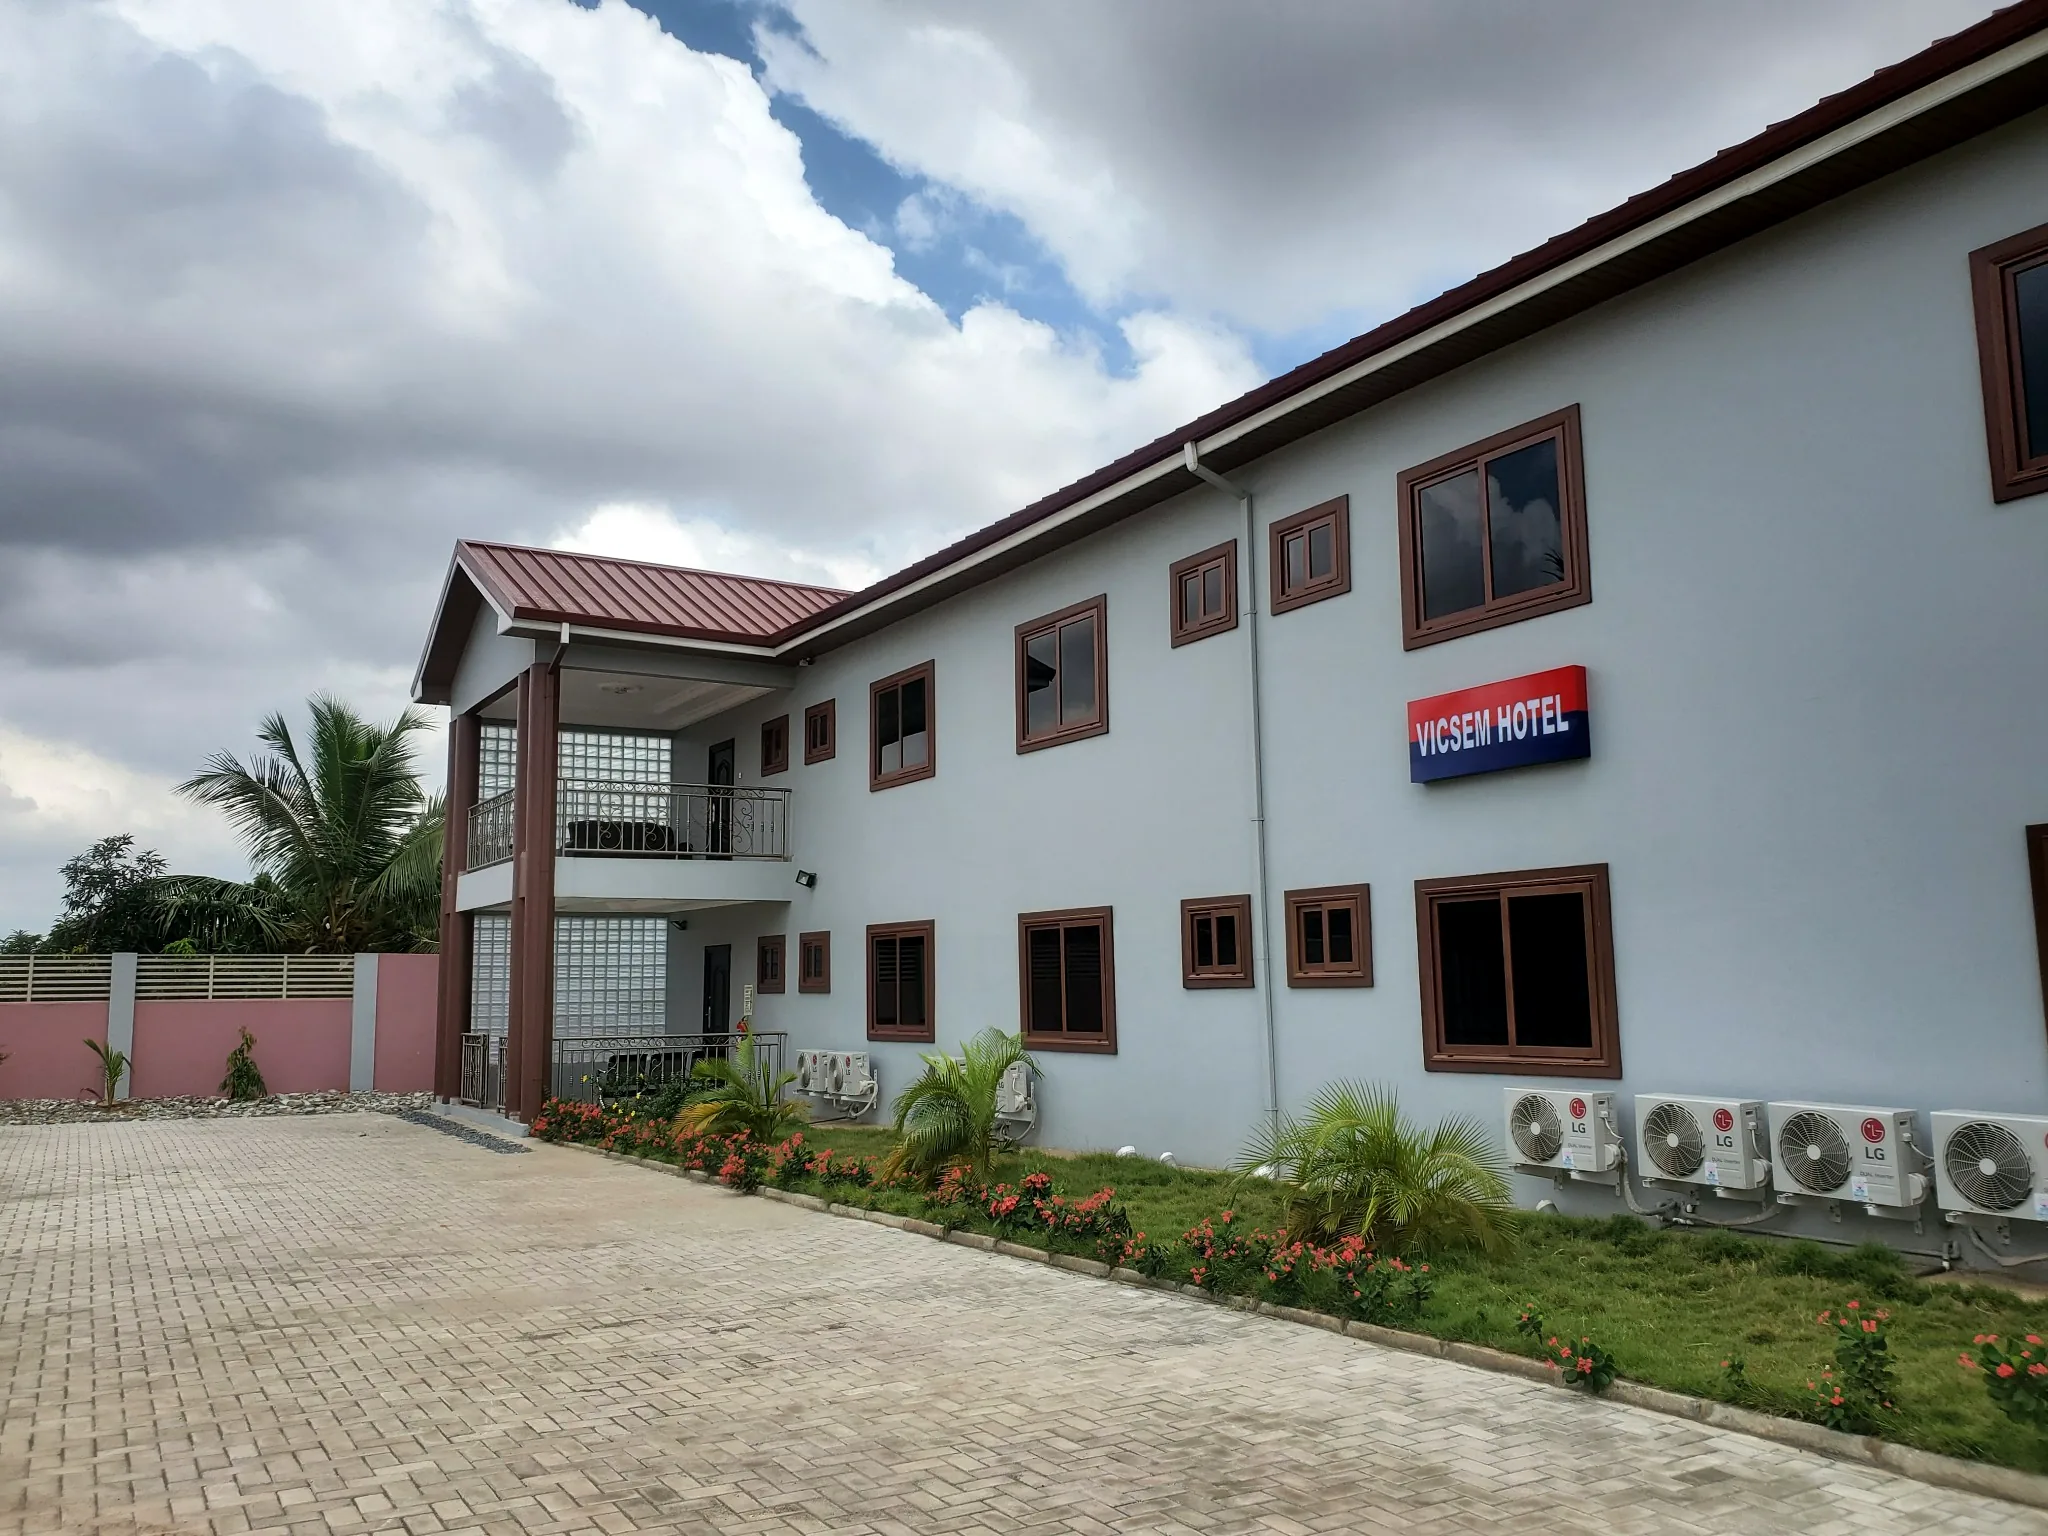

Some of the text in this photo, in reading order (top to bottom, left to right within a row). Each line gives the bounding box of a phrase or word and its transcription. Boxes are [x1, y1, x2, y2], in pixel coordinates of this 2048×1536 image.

[1416, 694, 1569, 757] VICSEM HOTEL
[1571, 1121, 1586, 1134] LG
[1716, 1134, 1733, 1148] LG
[1865, 1146, 1885, 1160] LG
